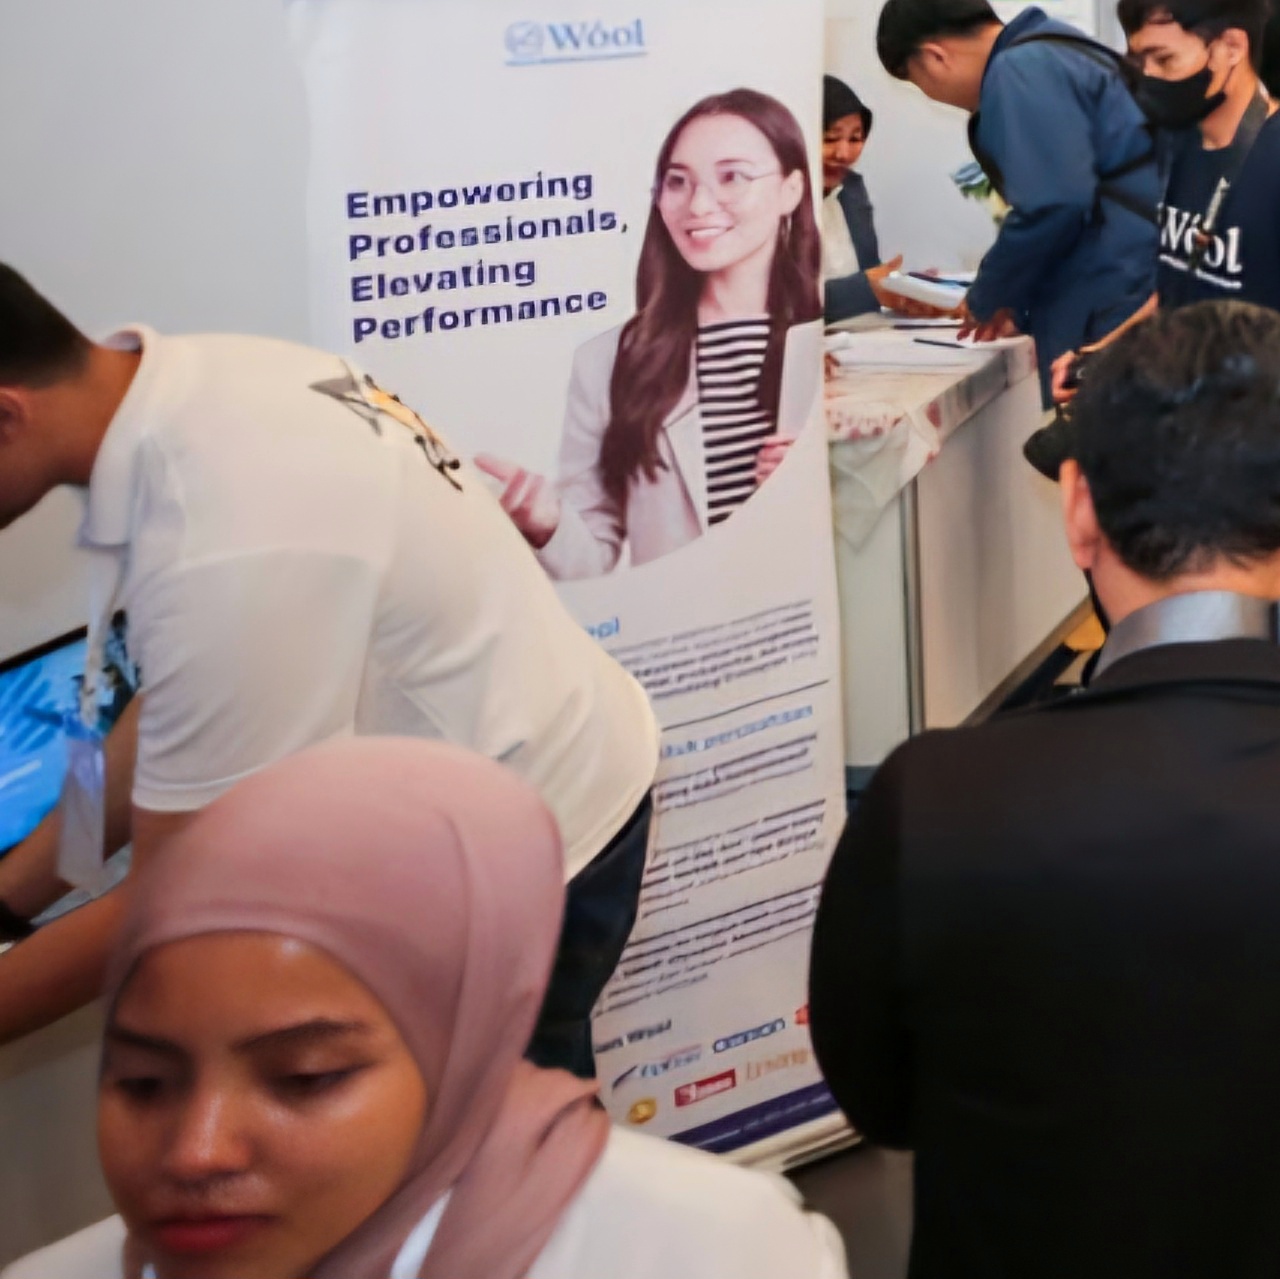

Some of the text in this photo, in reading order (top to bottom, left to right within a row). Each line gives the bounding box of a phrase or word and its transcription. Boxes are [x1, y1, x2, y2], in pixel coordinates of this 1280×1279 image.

[346, 171, 593, 220] Empowering
[349, 208, 628, 262] Professionals,
[351, 258, 536, 302] Elevating
[352, 290, 608, 344] Performance
